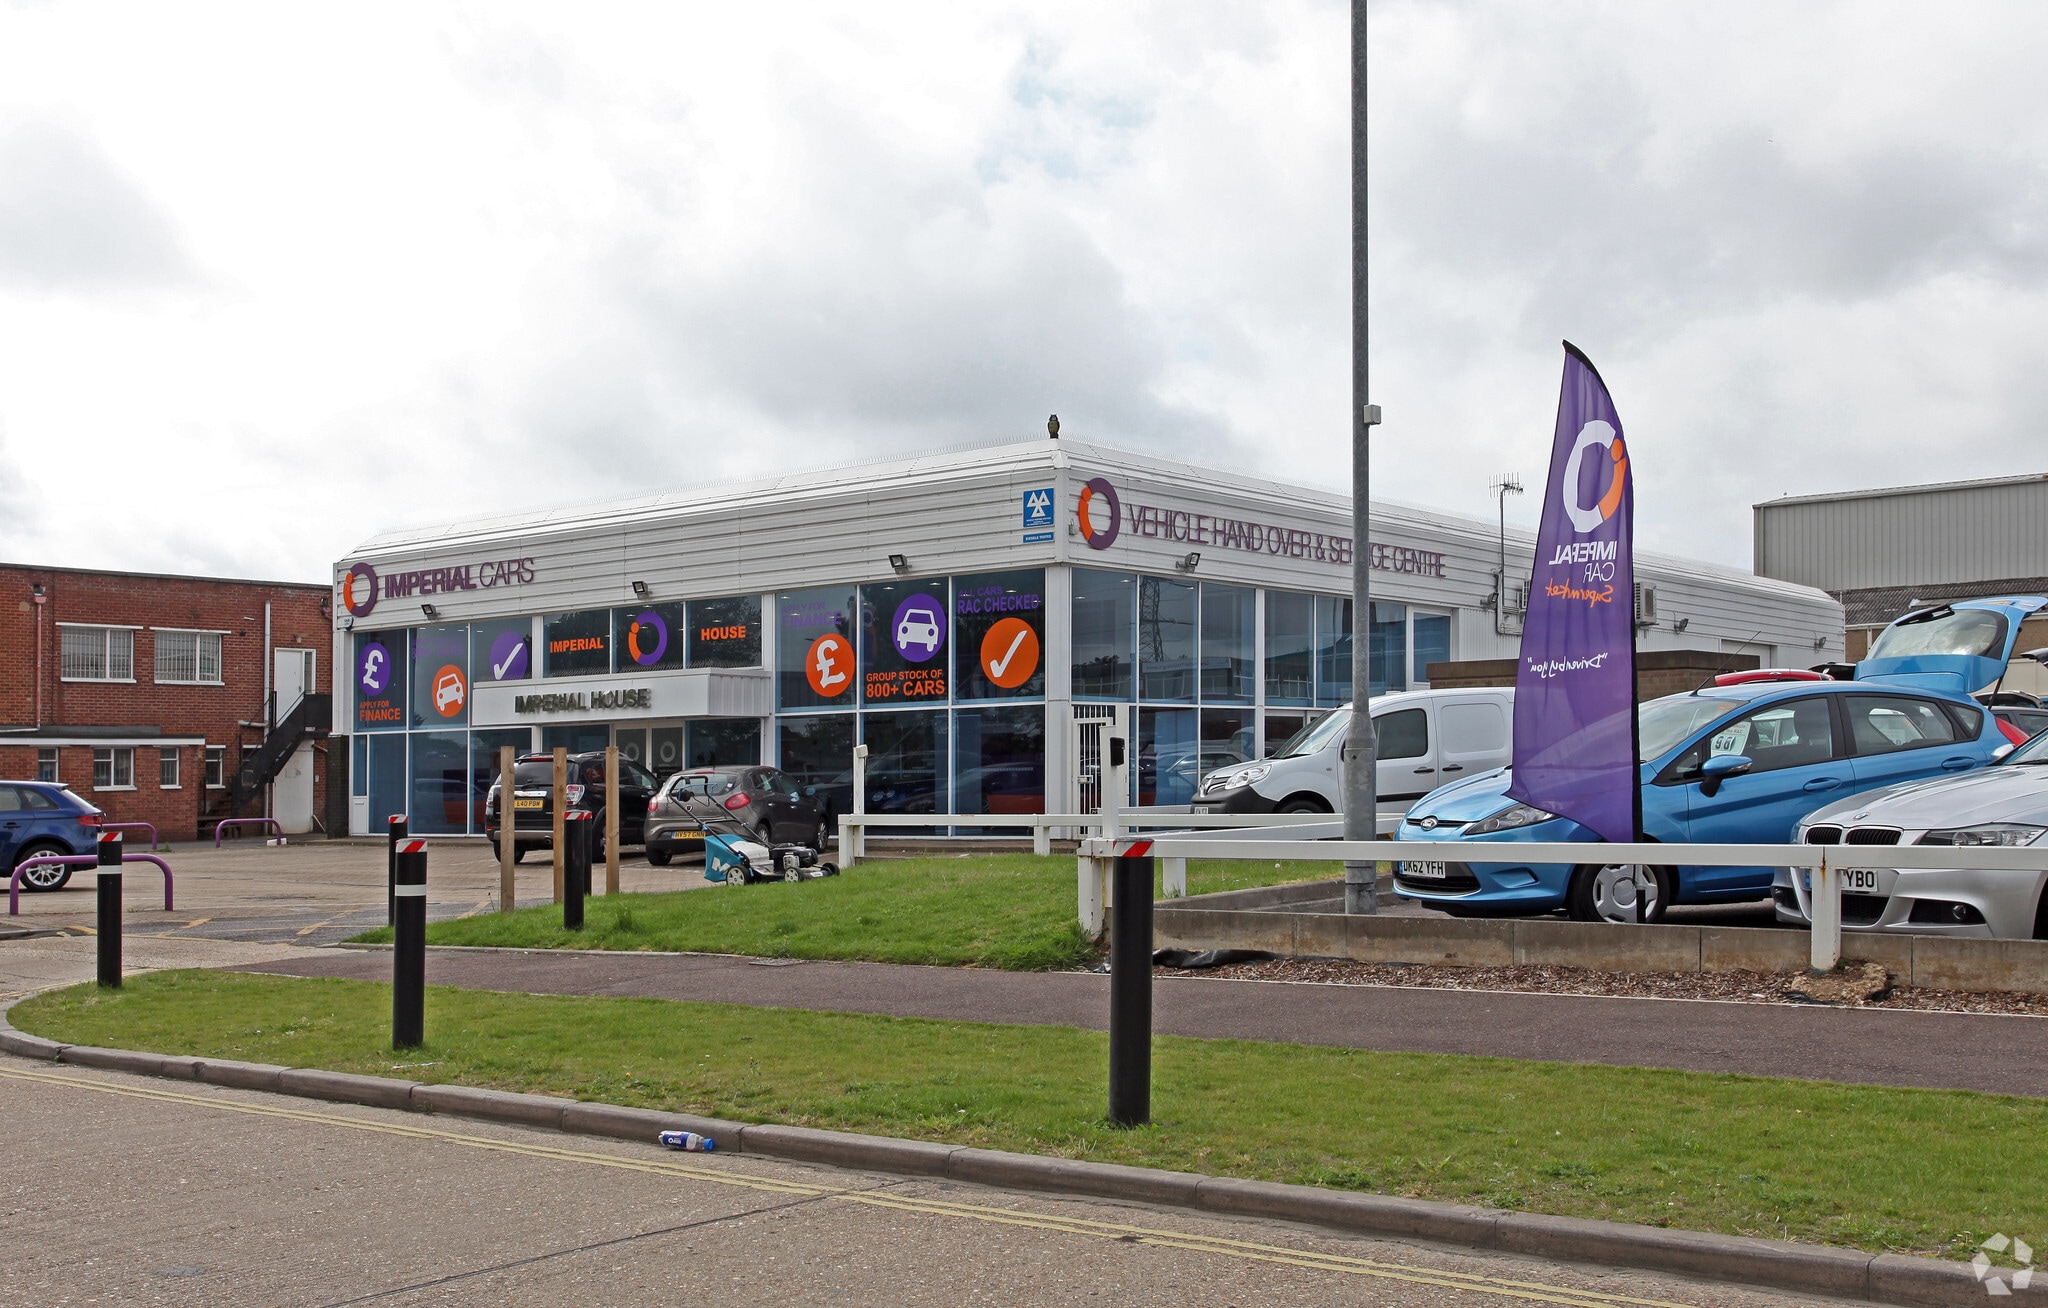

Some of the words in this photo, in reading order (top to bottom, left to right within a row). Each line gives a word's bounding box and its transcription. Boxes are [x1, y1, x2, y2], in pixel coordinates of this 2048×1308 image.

[1129, 503, 1209, 544] VEHICLE
[1213, 517, 1264, 551] HAND
[1267, 525, 1312, 558] OVER
[1315, 533, 1326, 560] &
[1328, 535, 1391, 569] SEICE
[1393, 545, 1447, 577] CENTRE
[384, 564, 477, 598] IMPERIAL
[479, 557, 535, 588] CARS
[977, 585, 1004, 597] CARS
[957, 598, 982, 614] RAC
[983, 593, 1041, 613] CHECKED
[781, 609, 843, 628] FINANCE
[701, 626, 746, 641] HOUSE
[549, 637, 604, 654] IMPERIAL
[866, 671, 897, 682] GROUP
[898, 670, 932, 681] STOCK
[932, 668, 943, 679] OF
[866, 683, 899, 698] 800+
[902, 679, 946, 697] CARS
[360, 701, 376, 709] APPLY
[377, 700, 390, 708] FOR
[514, 691, 588, 714] IMPERIAL
[590, 687, 651, 711] HOUSE
[360, 708, 401, 721] FINANCE
[1425, 861, 1444, 876] YFH
[1846, 869, 1875, 888] YBO
